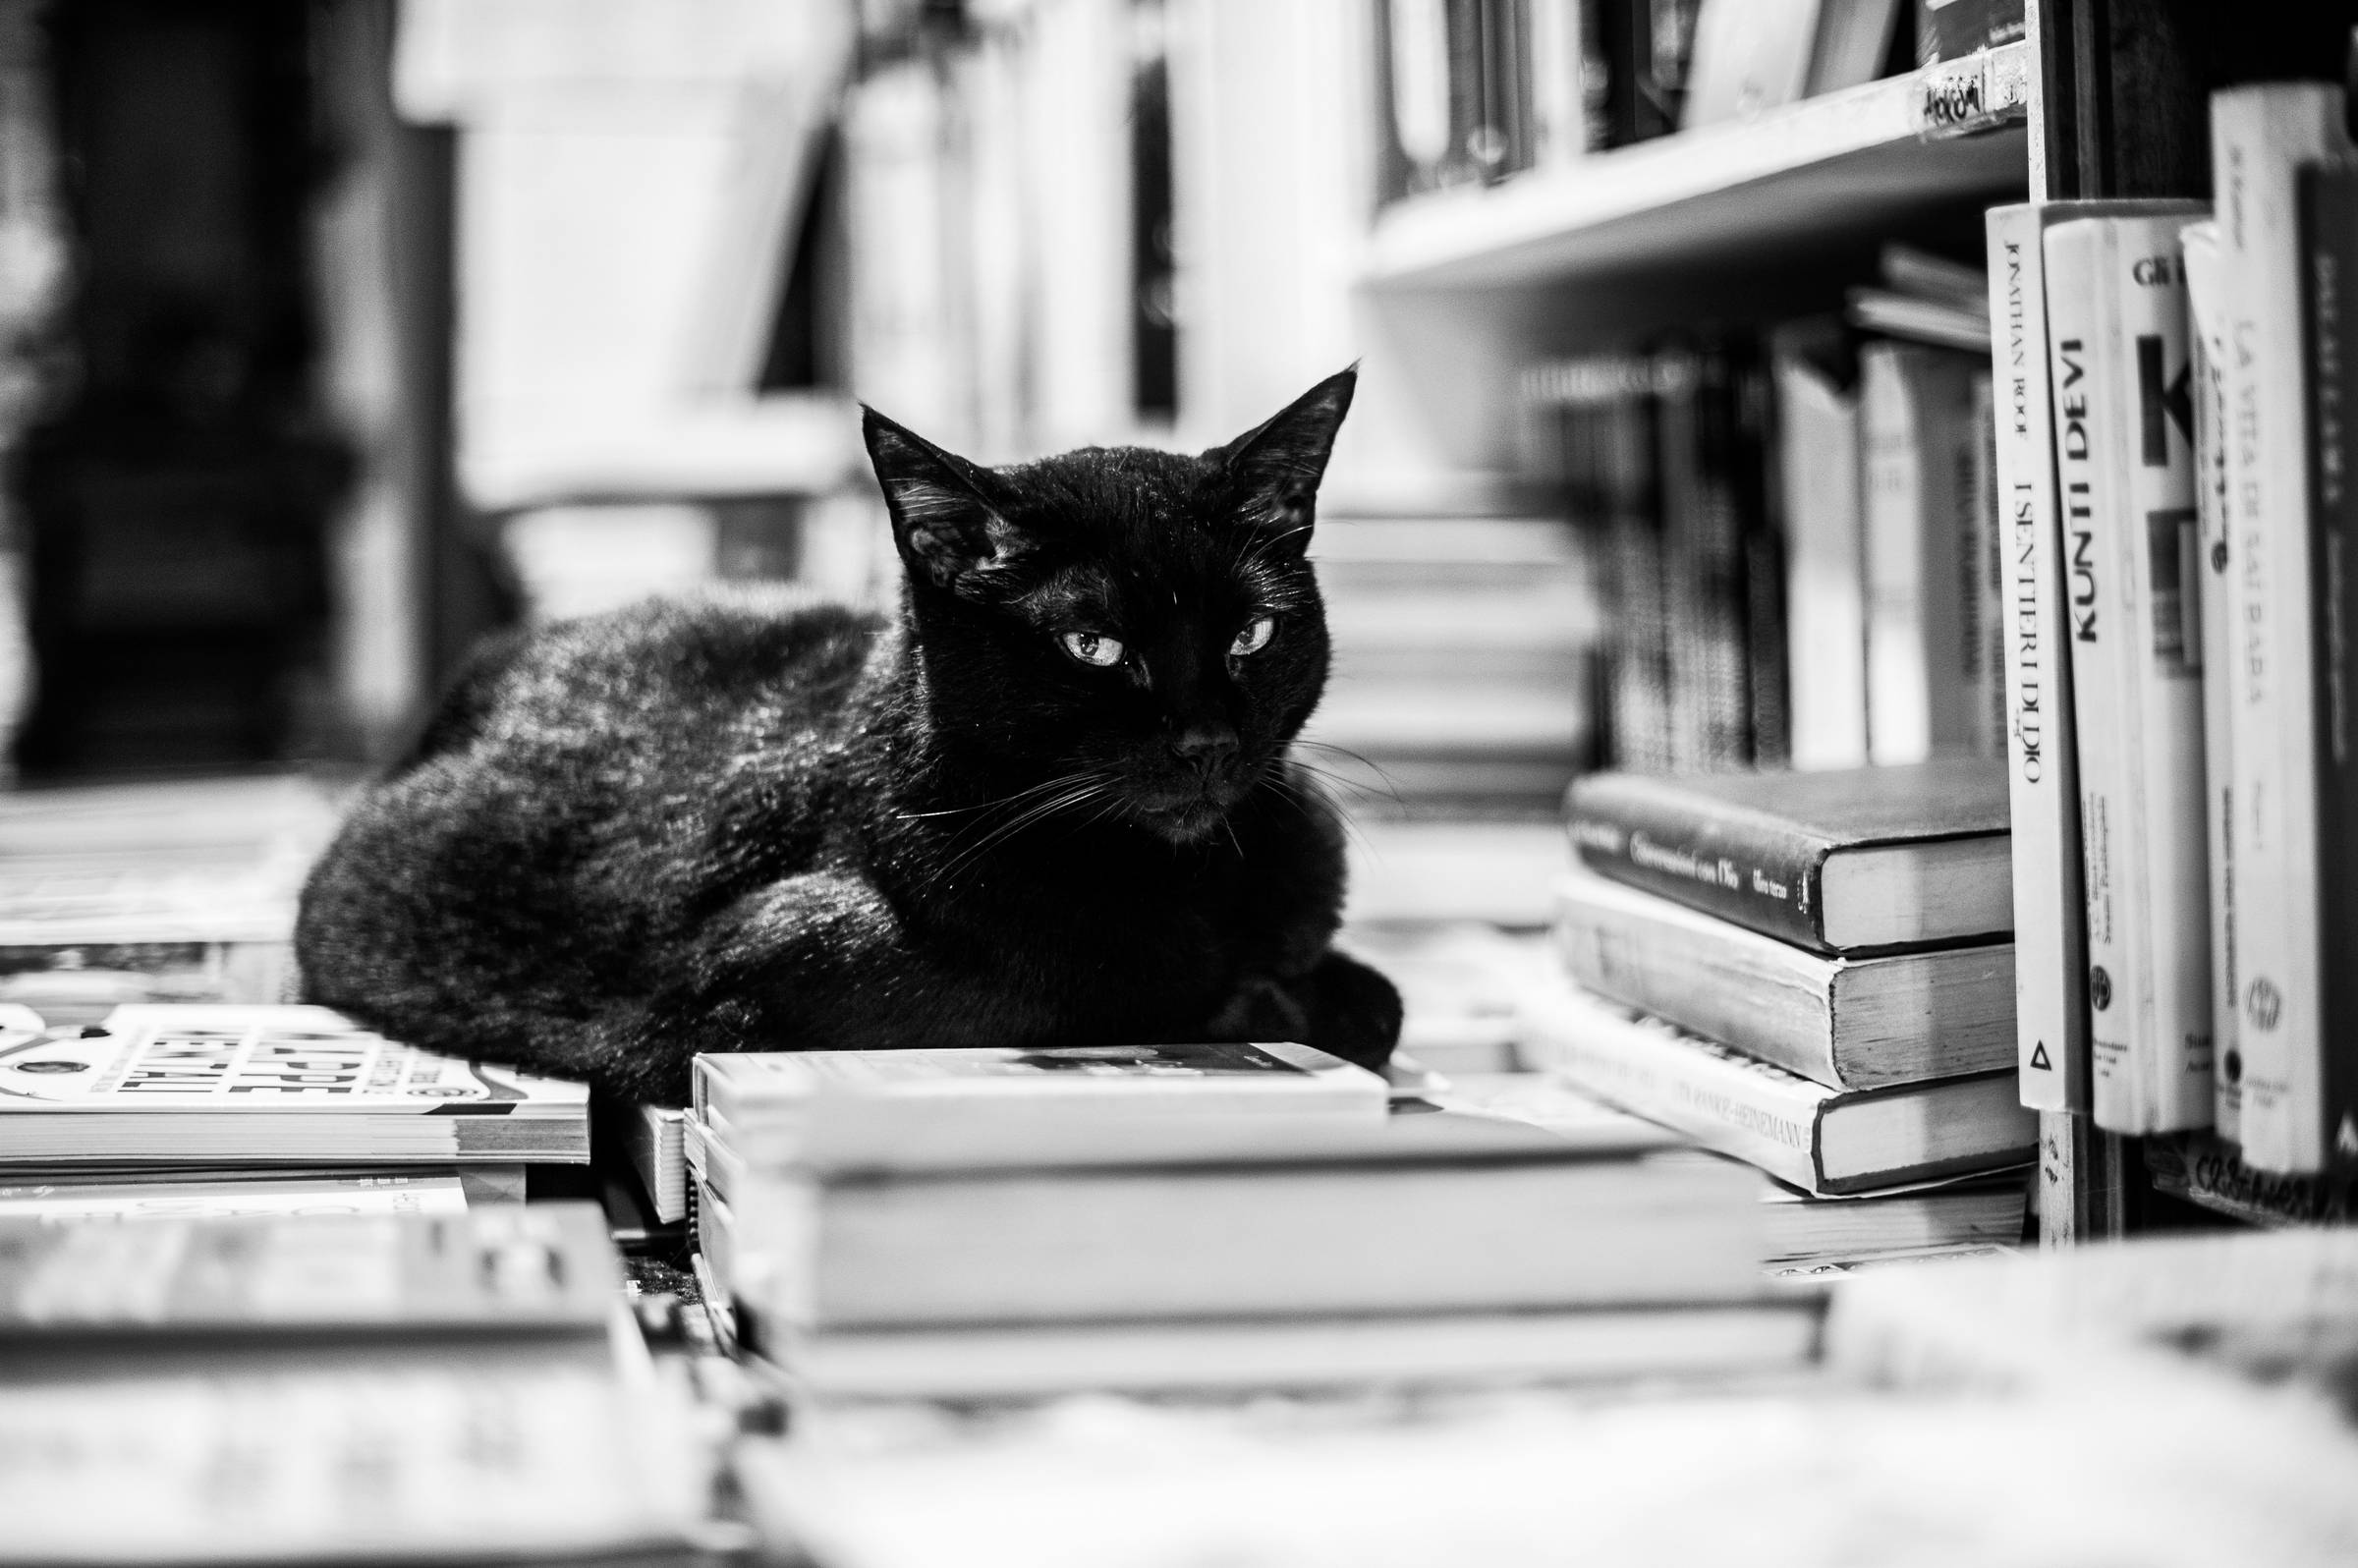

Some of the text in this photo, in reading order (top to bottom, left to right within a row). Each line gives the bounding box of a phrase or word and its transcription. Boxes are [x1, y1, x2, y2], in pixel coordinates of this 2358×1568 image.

[2003, 240, 2026, 367] JONATHAN
[2059, 338, 2098, 644] KUNTI DEVI
[2014, 500, 2039, 669] SENTIERI
[2021, 682, 2040, 714] DI
[2021, 725, 2042, 784] DIO
